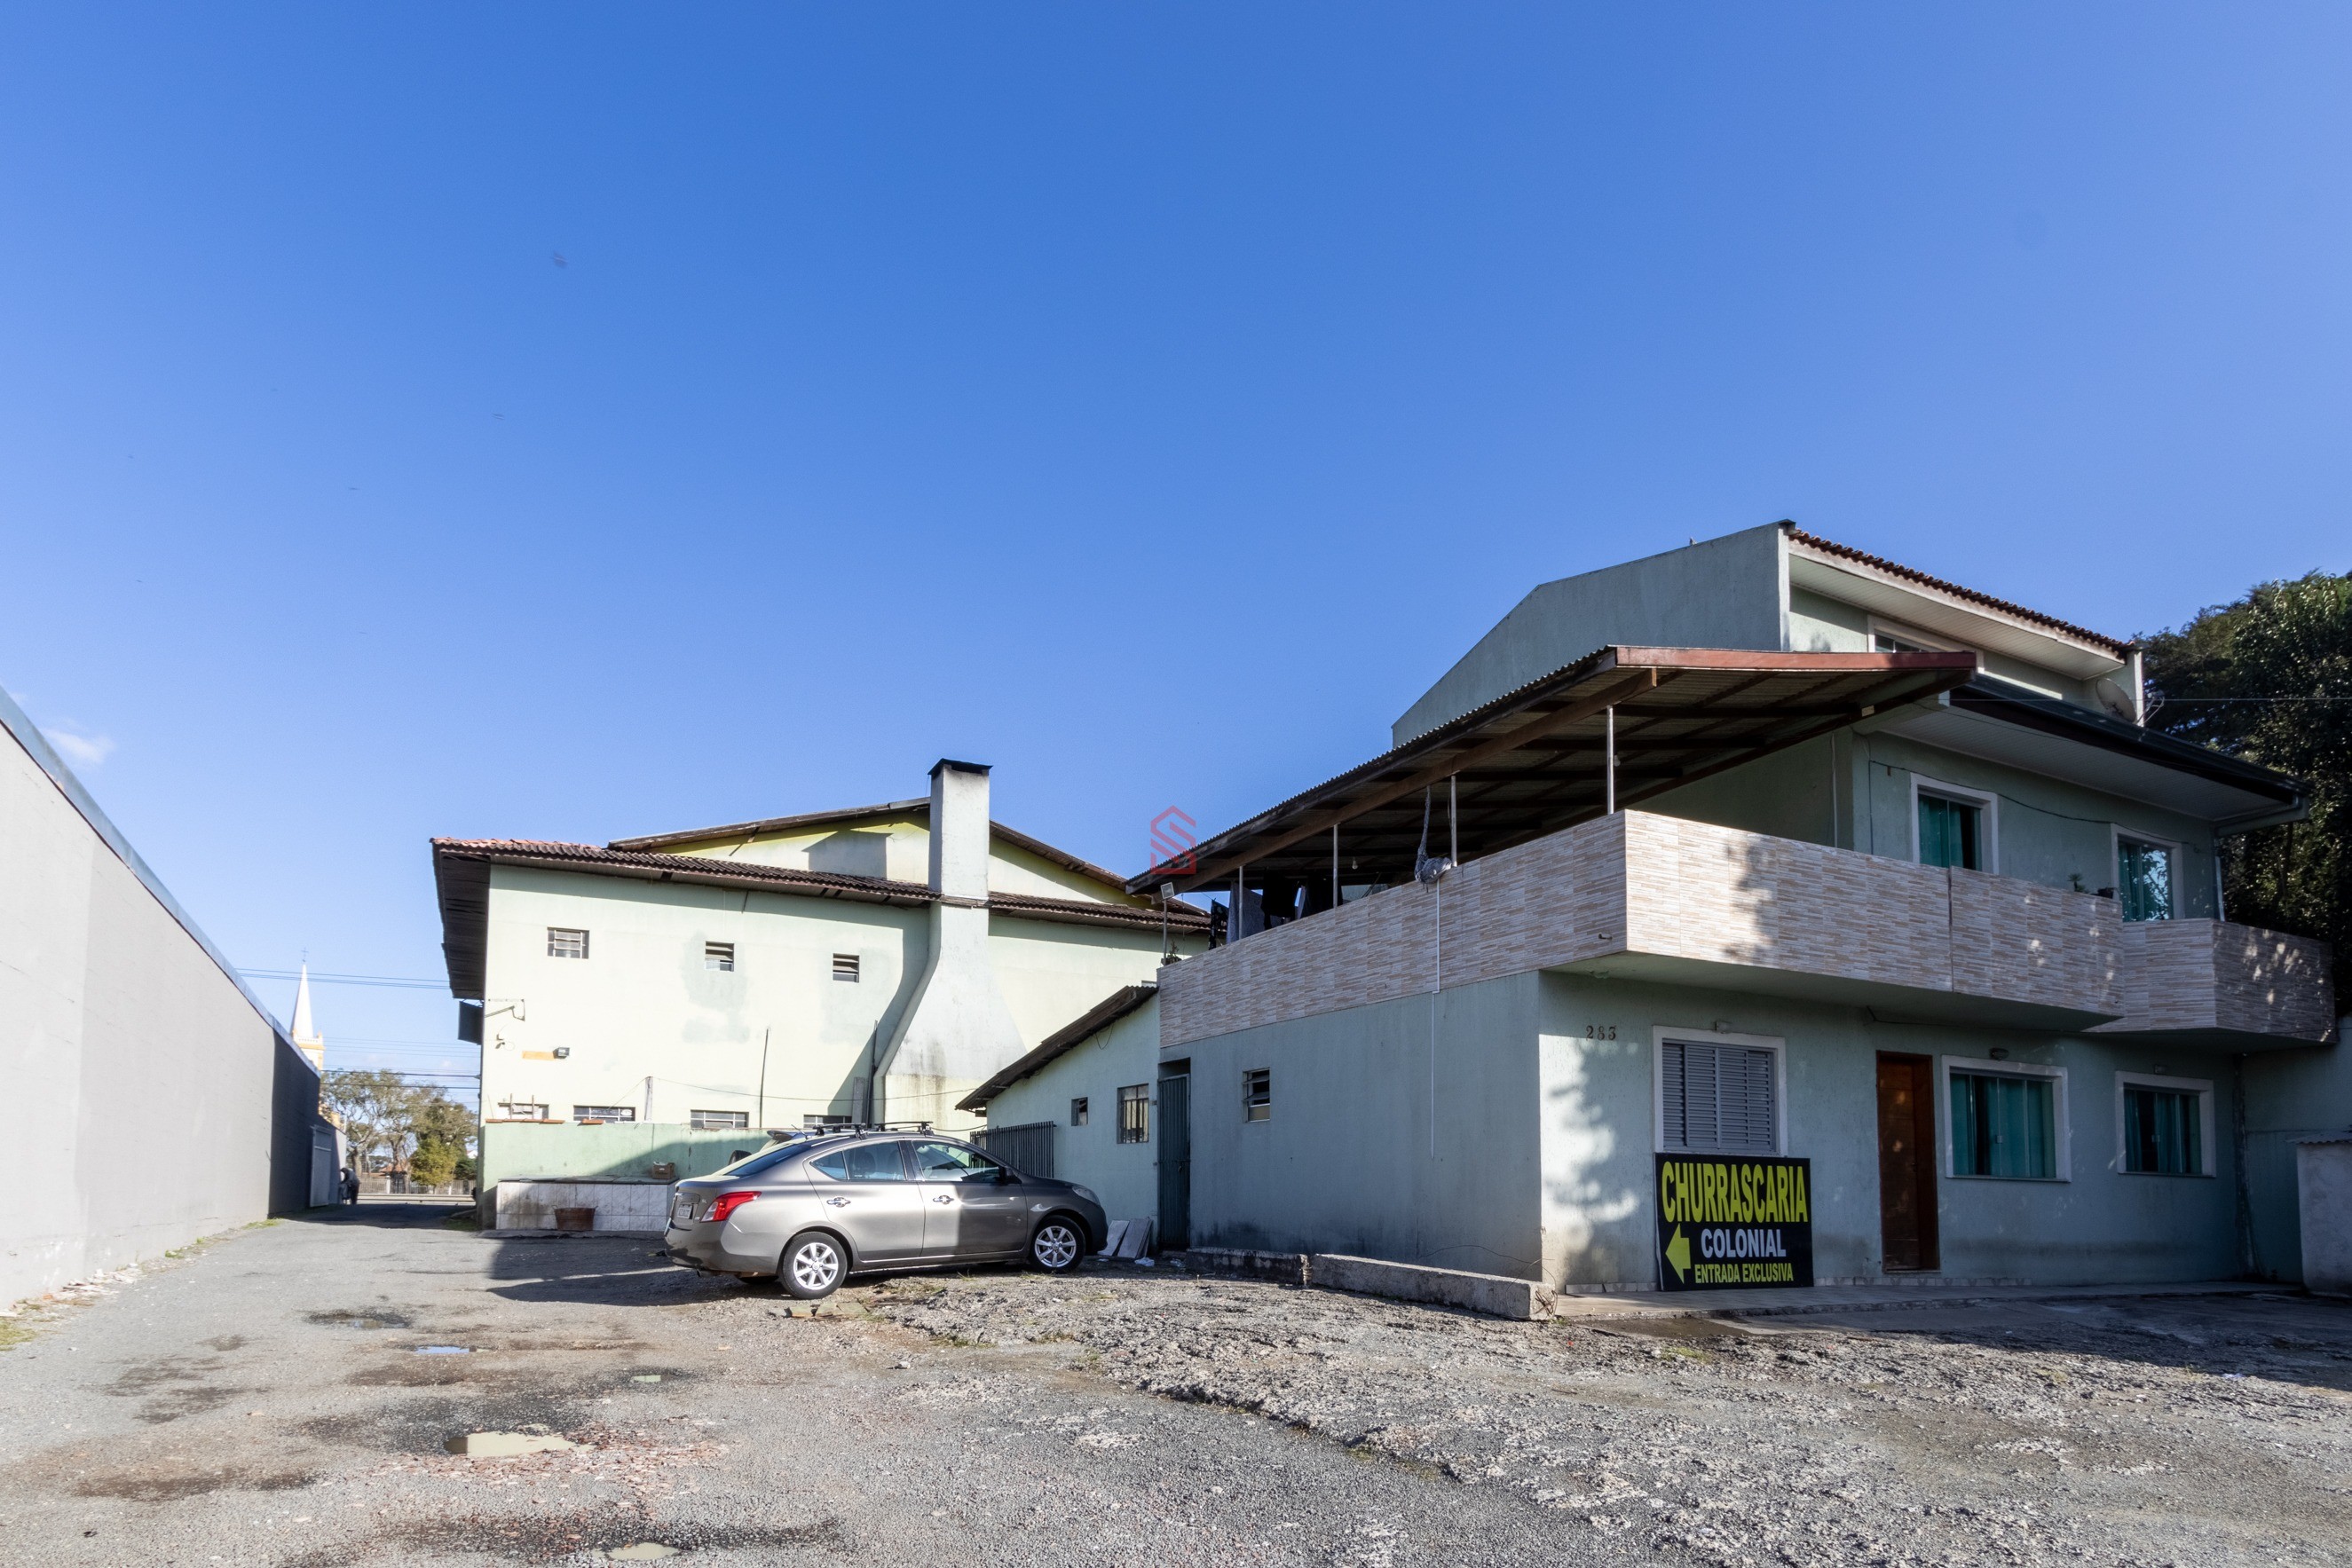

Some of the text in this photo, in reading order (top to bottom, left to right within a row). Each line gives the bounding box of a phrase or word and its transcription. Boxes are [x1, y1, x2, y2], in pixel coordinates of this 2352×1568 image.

[1586, 1025, 1616, 1041] 283
[1661, 1161, 1808, 1223] CHURRASCARIA
[1701, 1228, 1787, 1258] COLONIAL
[1694, 1263, 1794, 1283] ENTRADA EXCLUSIVA
